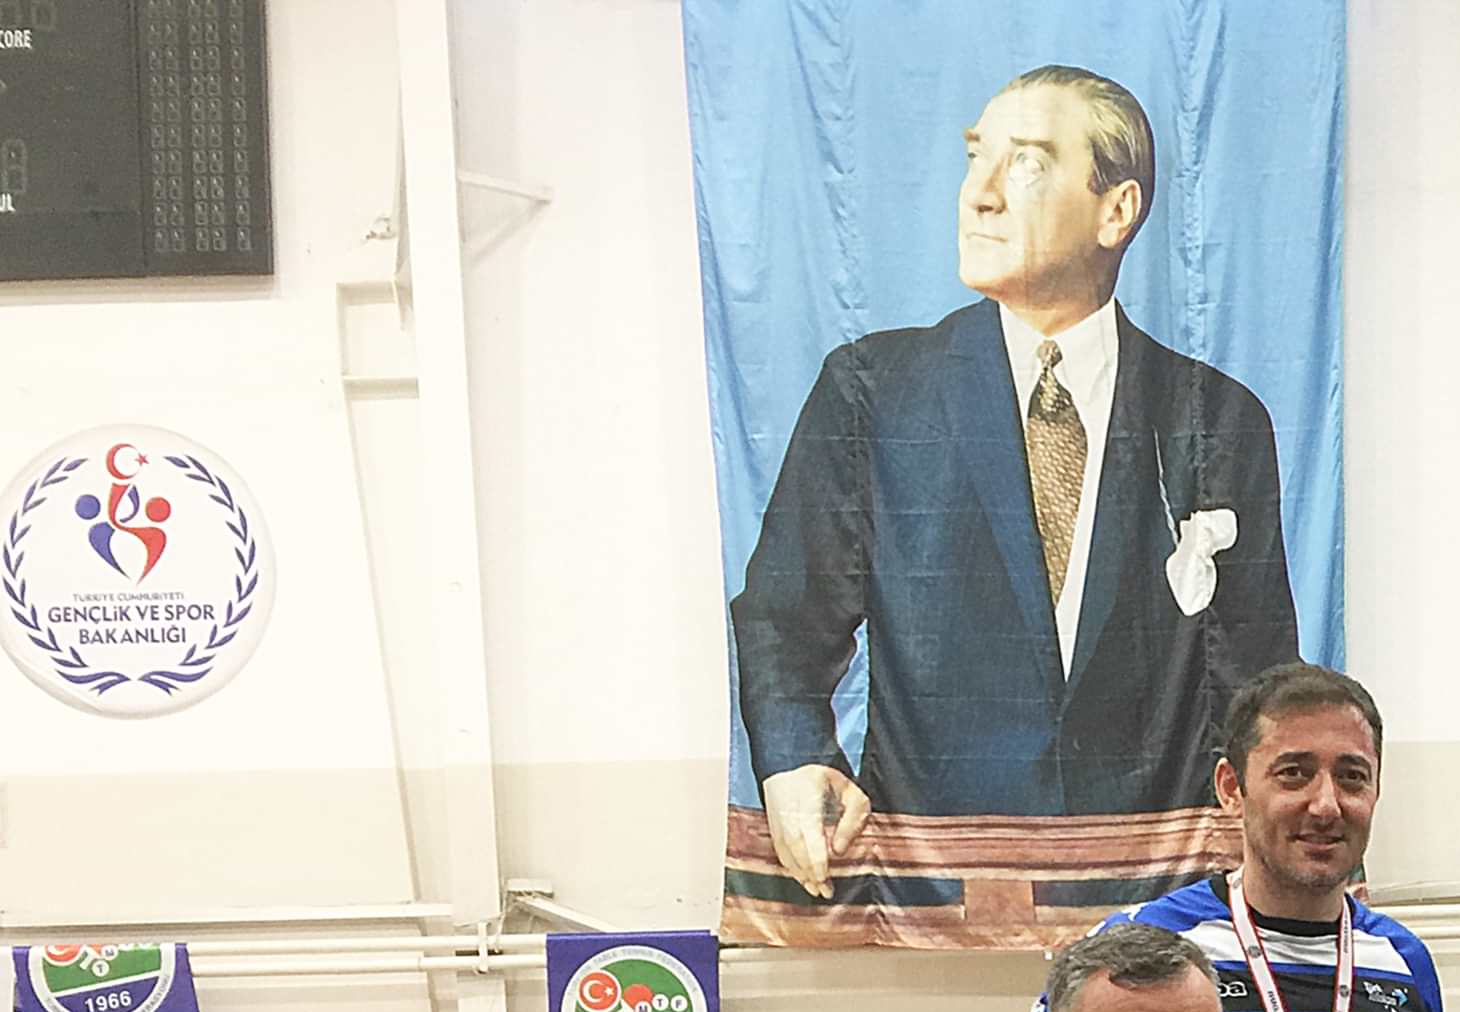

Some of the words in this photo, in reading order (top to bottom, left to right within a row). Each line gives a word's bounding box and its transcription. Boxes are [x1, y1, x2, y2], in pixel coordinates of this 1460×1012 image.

[135, 605, 160, 621] VE
[164, 604, 215, 622] SPOR
[79, 625, 187, 645] BAKANLIĞI
